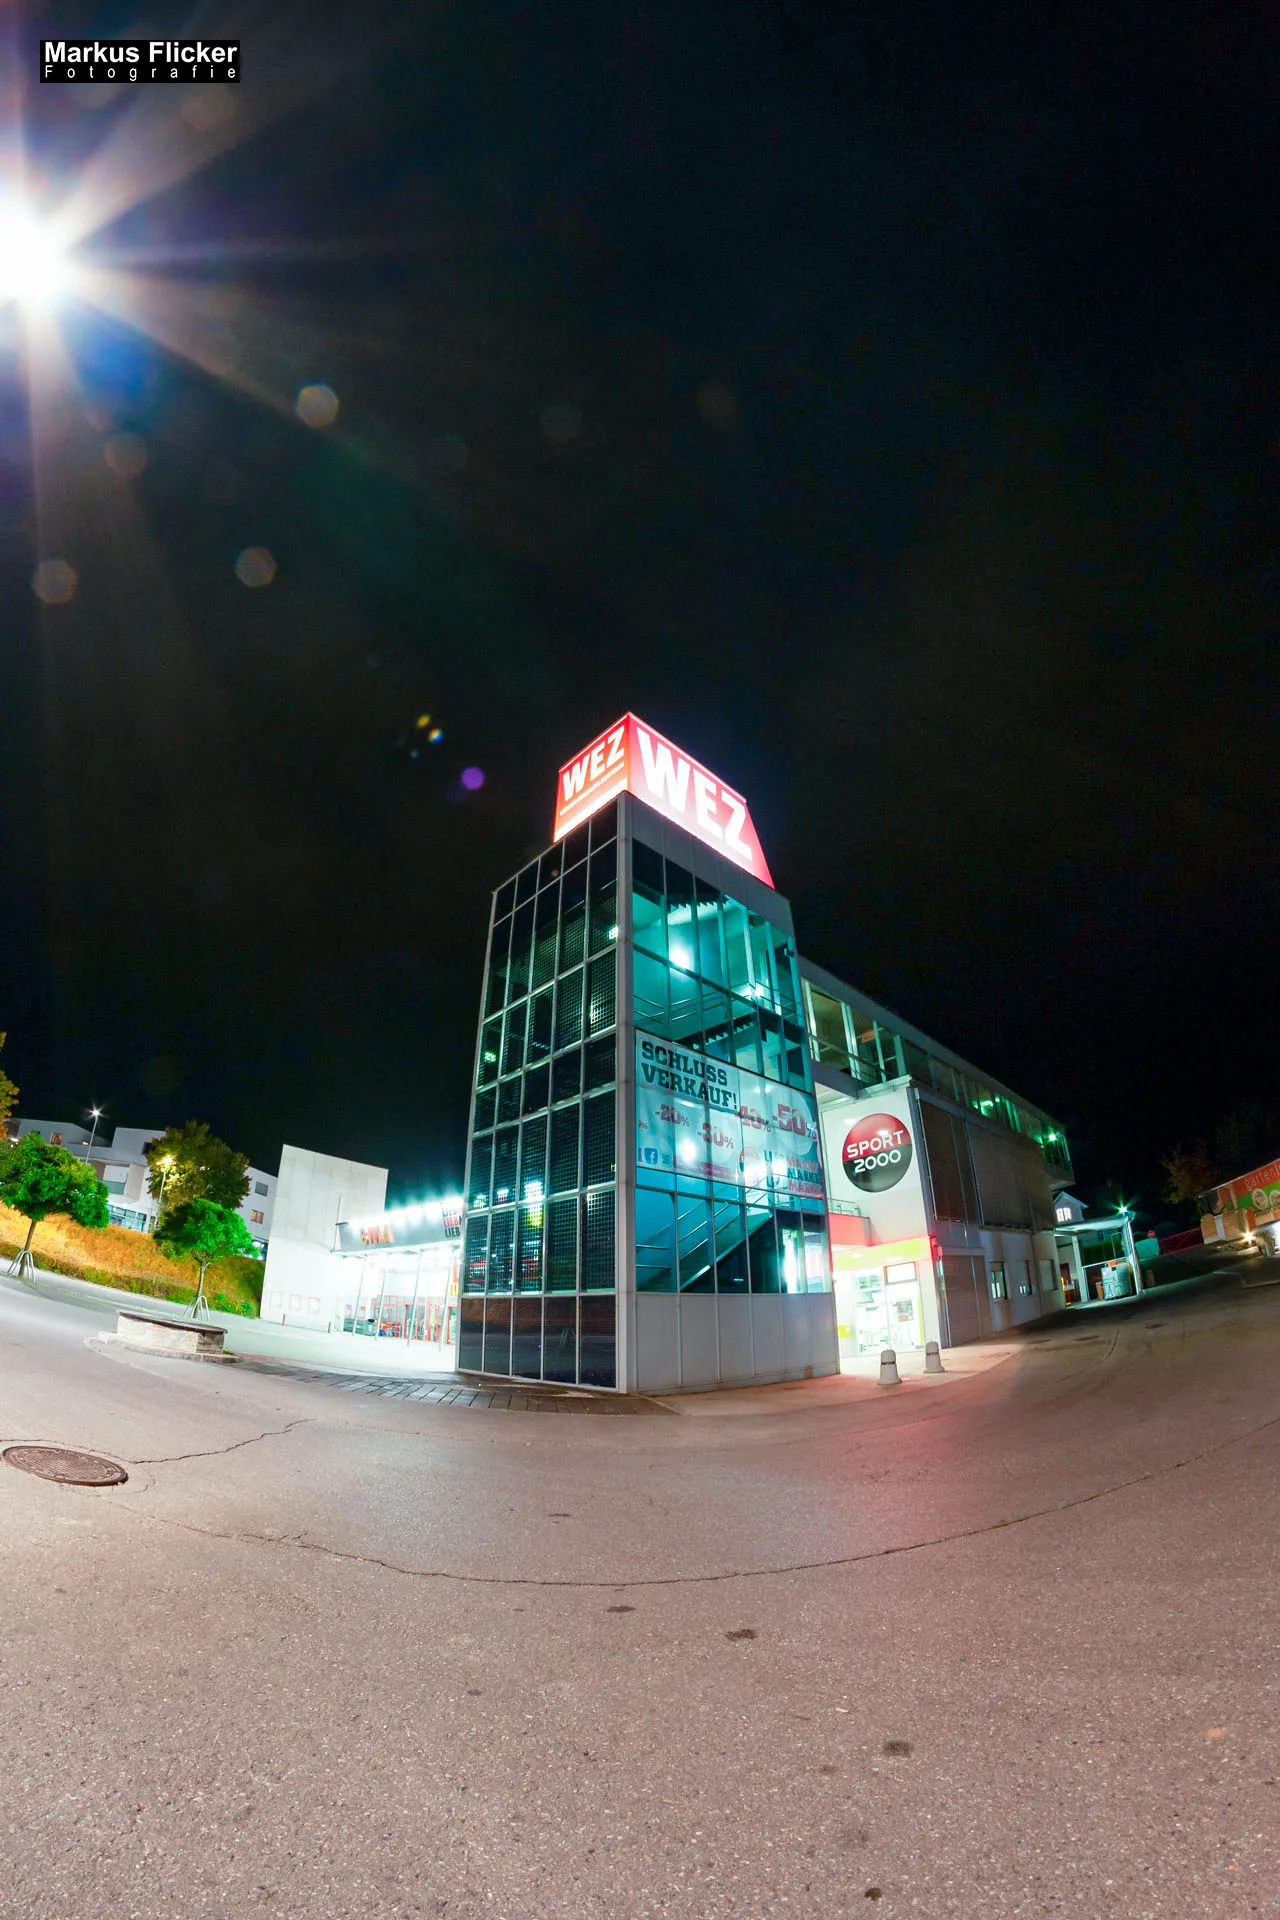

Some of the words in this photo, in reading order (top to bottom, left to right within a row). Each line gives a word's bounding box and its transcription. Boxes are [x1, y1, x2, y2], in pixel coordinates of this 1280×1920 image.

[562, 724, 625, 802] WEZ
[636, 727, 753, 861] WEZ
[640, 1062, 738, 1110] VERKAUF!
[641, 1040, 728, 1087] SCHLUSS
[847, 1130, 904, 1158] SPORT
[854, 1149, 902, 1173] 2000
